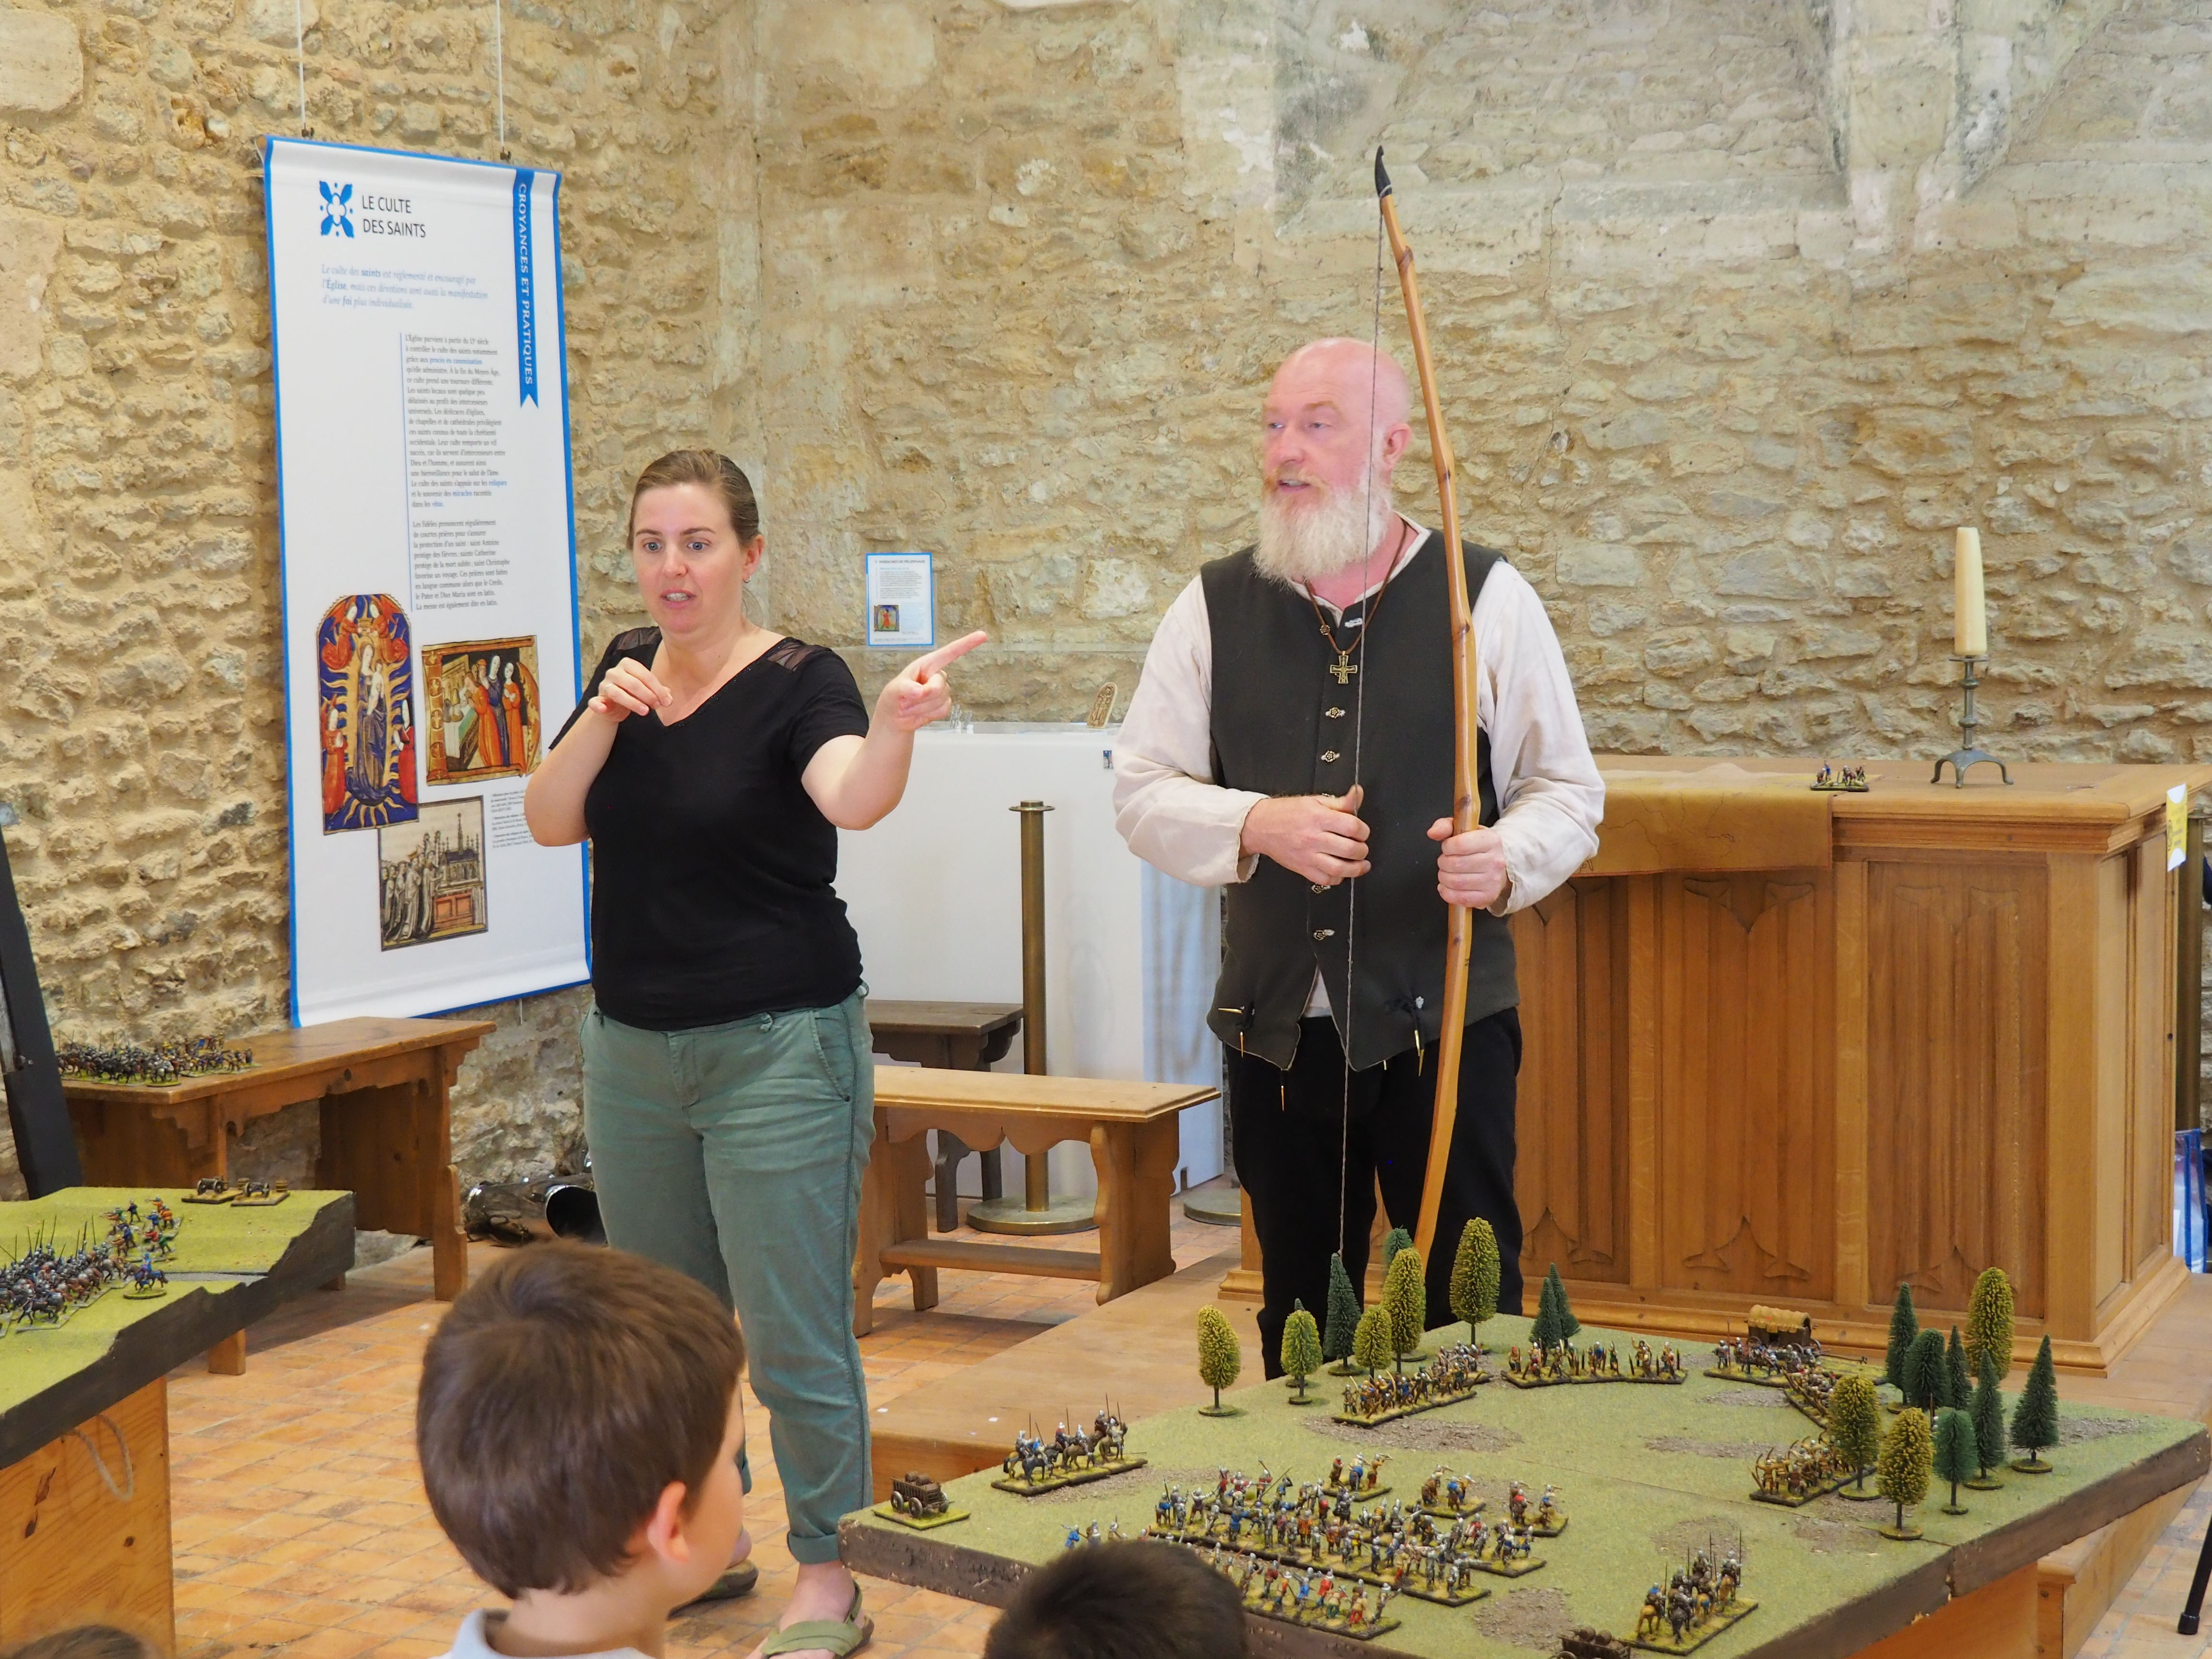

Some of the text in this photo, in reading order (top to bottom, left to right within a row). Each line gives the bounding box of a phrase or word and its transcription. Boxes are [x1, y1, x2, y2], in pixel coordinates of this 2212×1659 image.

[362, 195, 411, 214] LE CULTE
[363, 218, 426, 238] DES SAINTS
[518, 183, 533, 385] CROYANCES ET PRATIQUES
